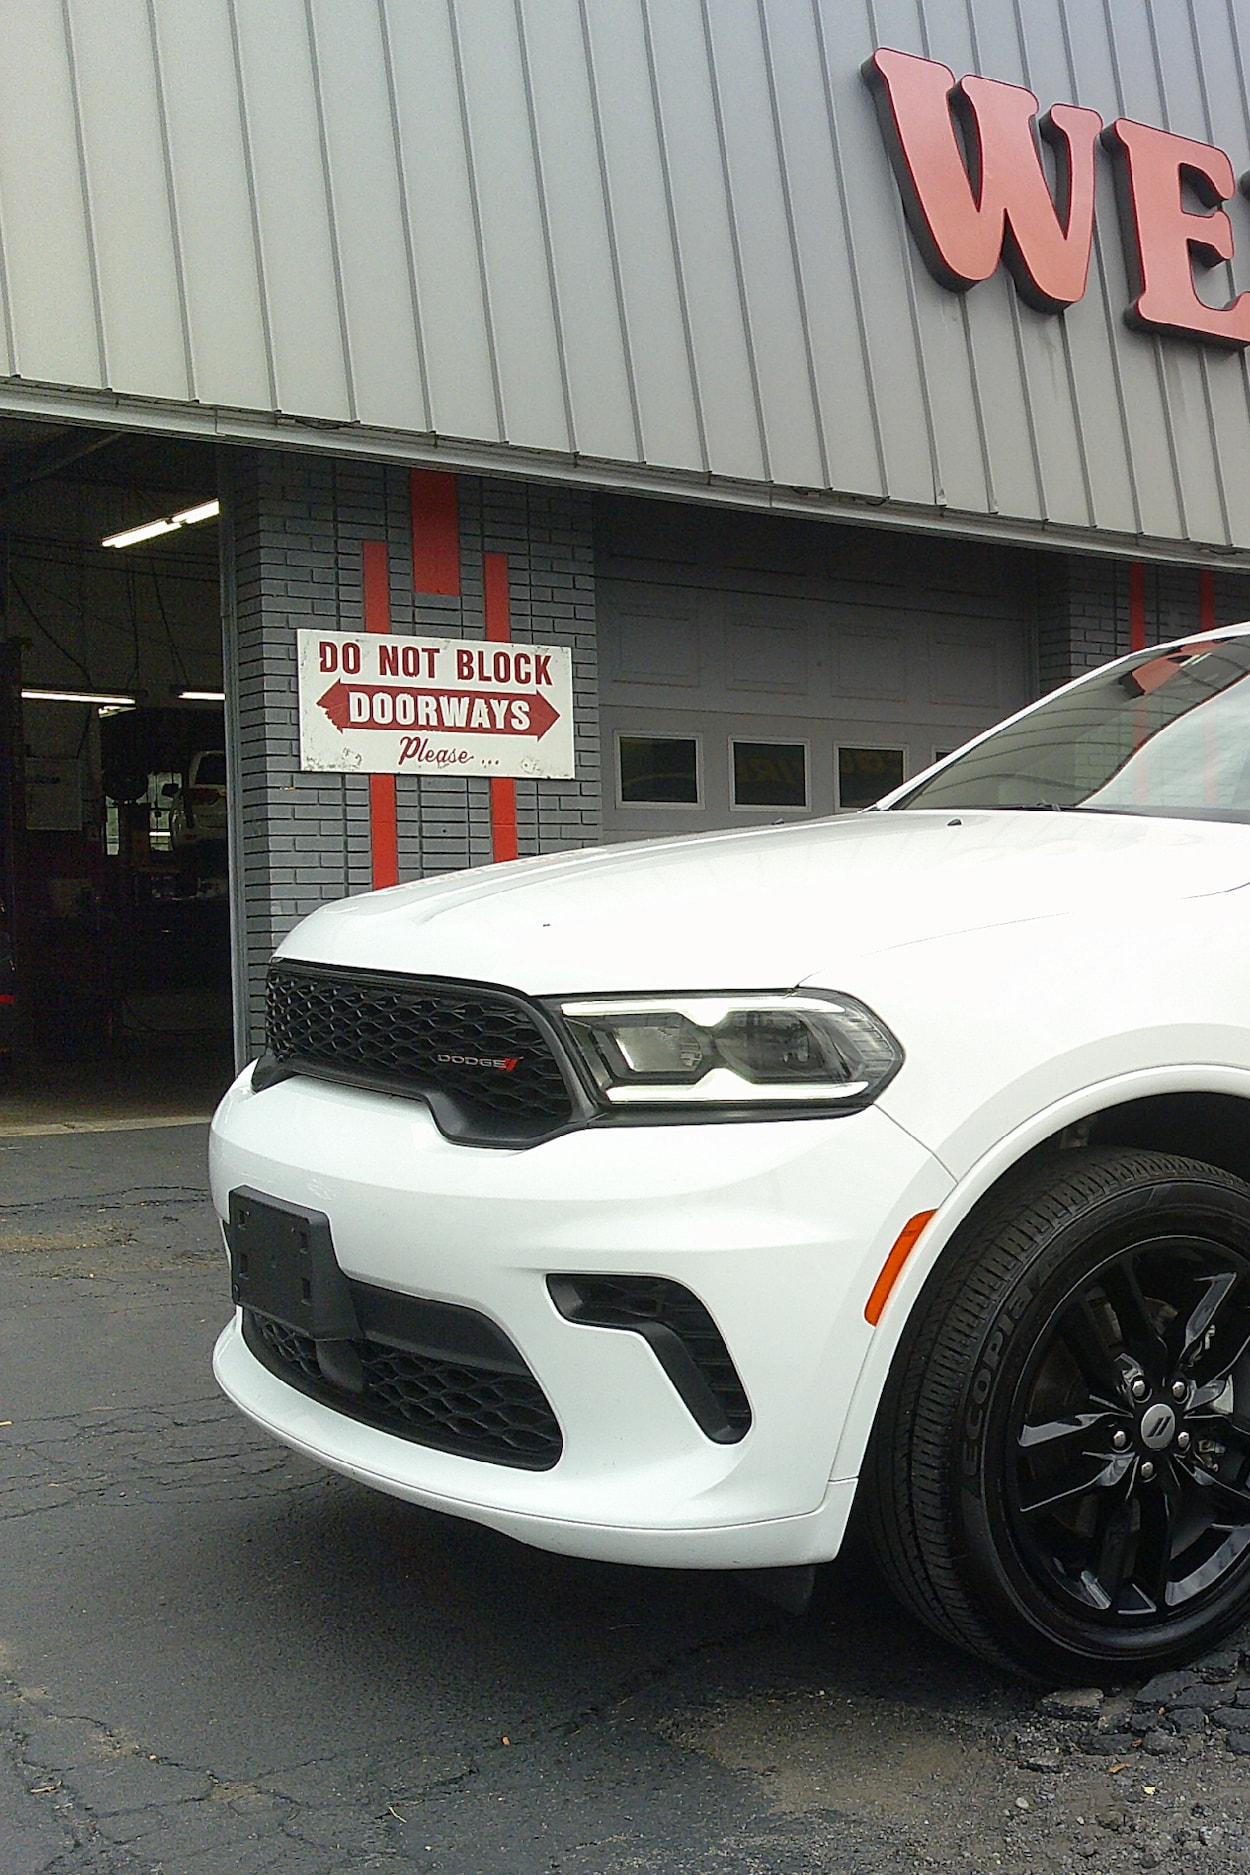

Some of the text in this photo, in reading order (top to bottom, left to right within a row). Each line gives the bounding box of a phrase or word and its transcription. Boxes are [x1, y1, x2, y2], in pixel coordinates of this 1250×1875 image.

[319, 641, 553, 686] DO NOT BLOCK
[350, 692, 531, 731] DOORWAYS
[398, 736, 475, 766] Please
[437, 1054, 507, 1069] DODGE
[963, 1284, 1035, 1477] ECOPIA
